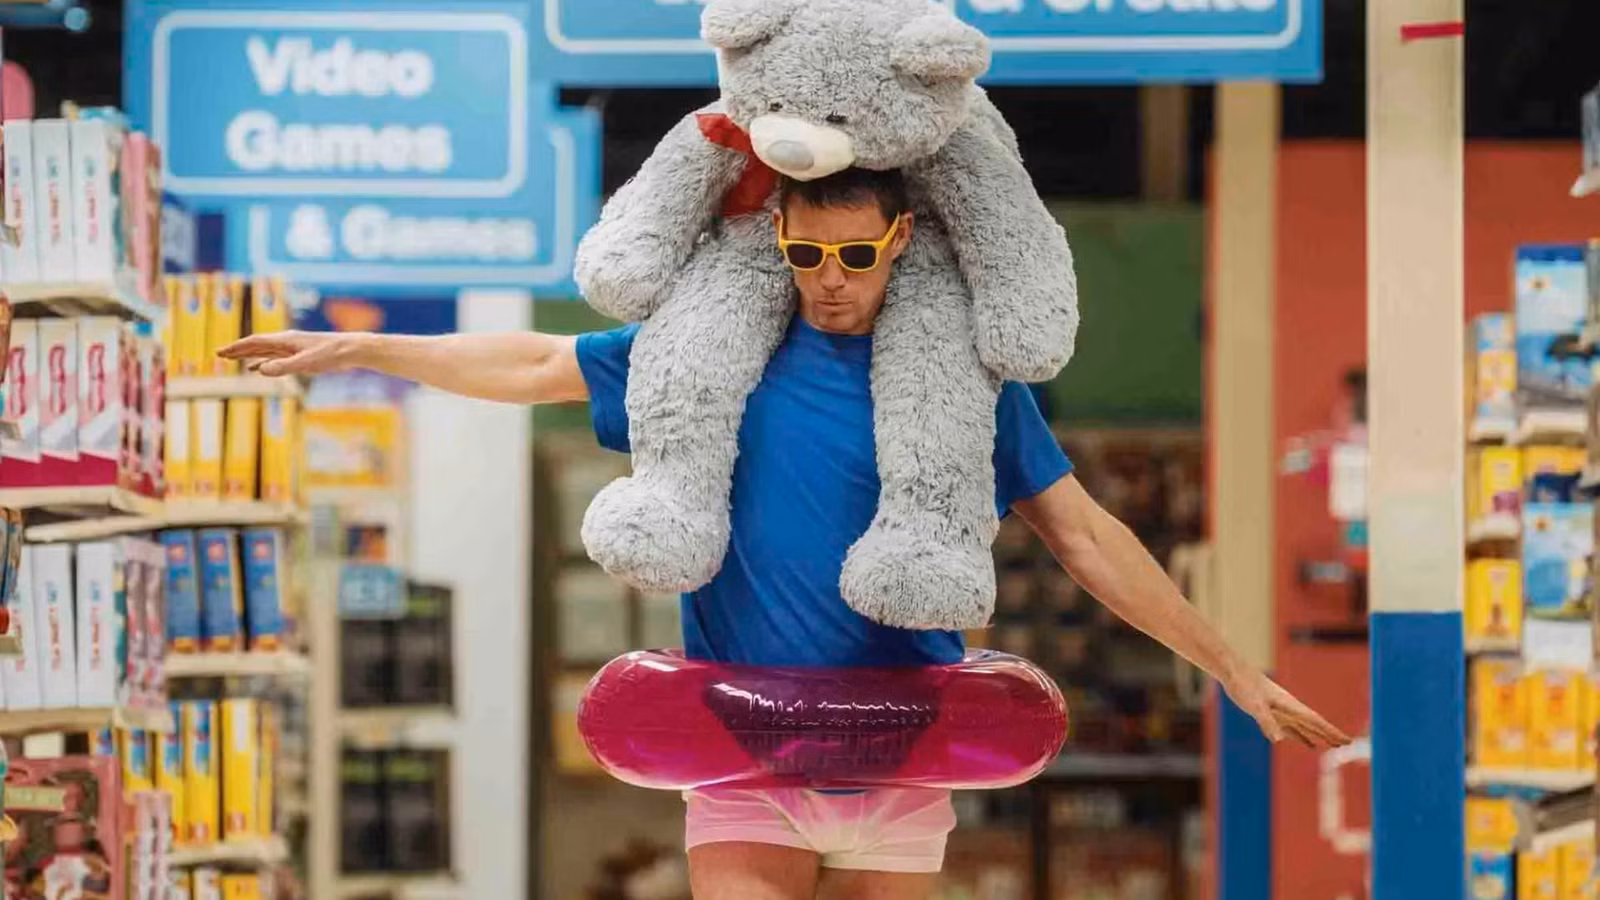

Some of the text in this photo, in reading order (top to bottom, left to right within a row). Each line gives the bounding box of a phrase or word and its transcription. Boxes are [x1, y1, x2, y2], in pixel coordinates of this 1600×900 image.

[246, 38, 433, 95] Video
[226, 110, 452, 172] Games
[286, 204, 537, 260] & Games
